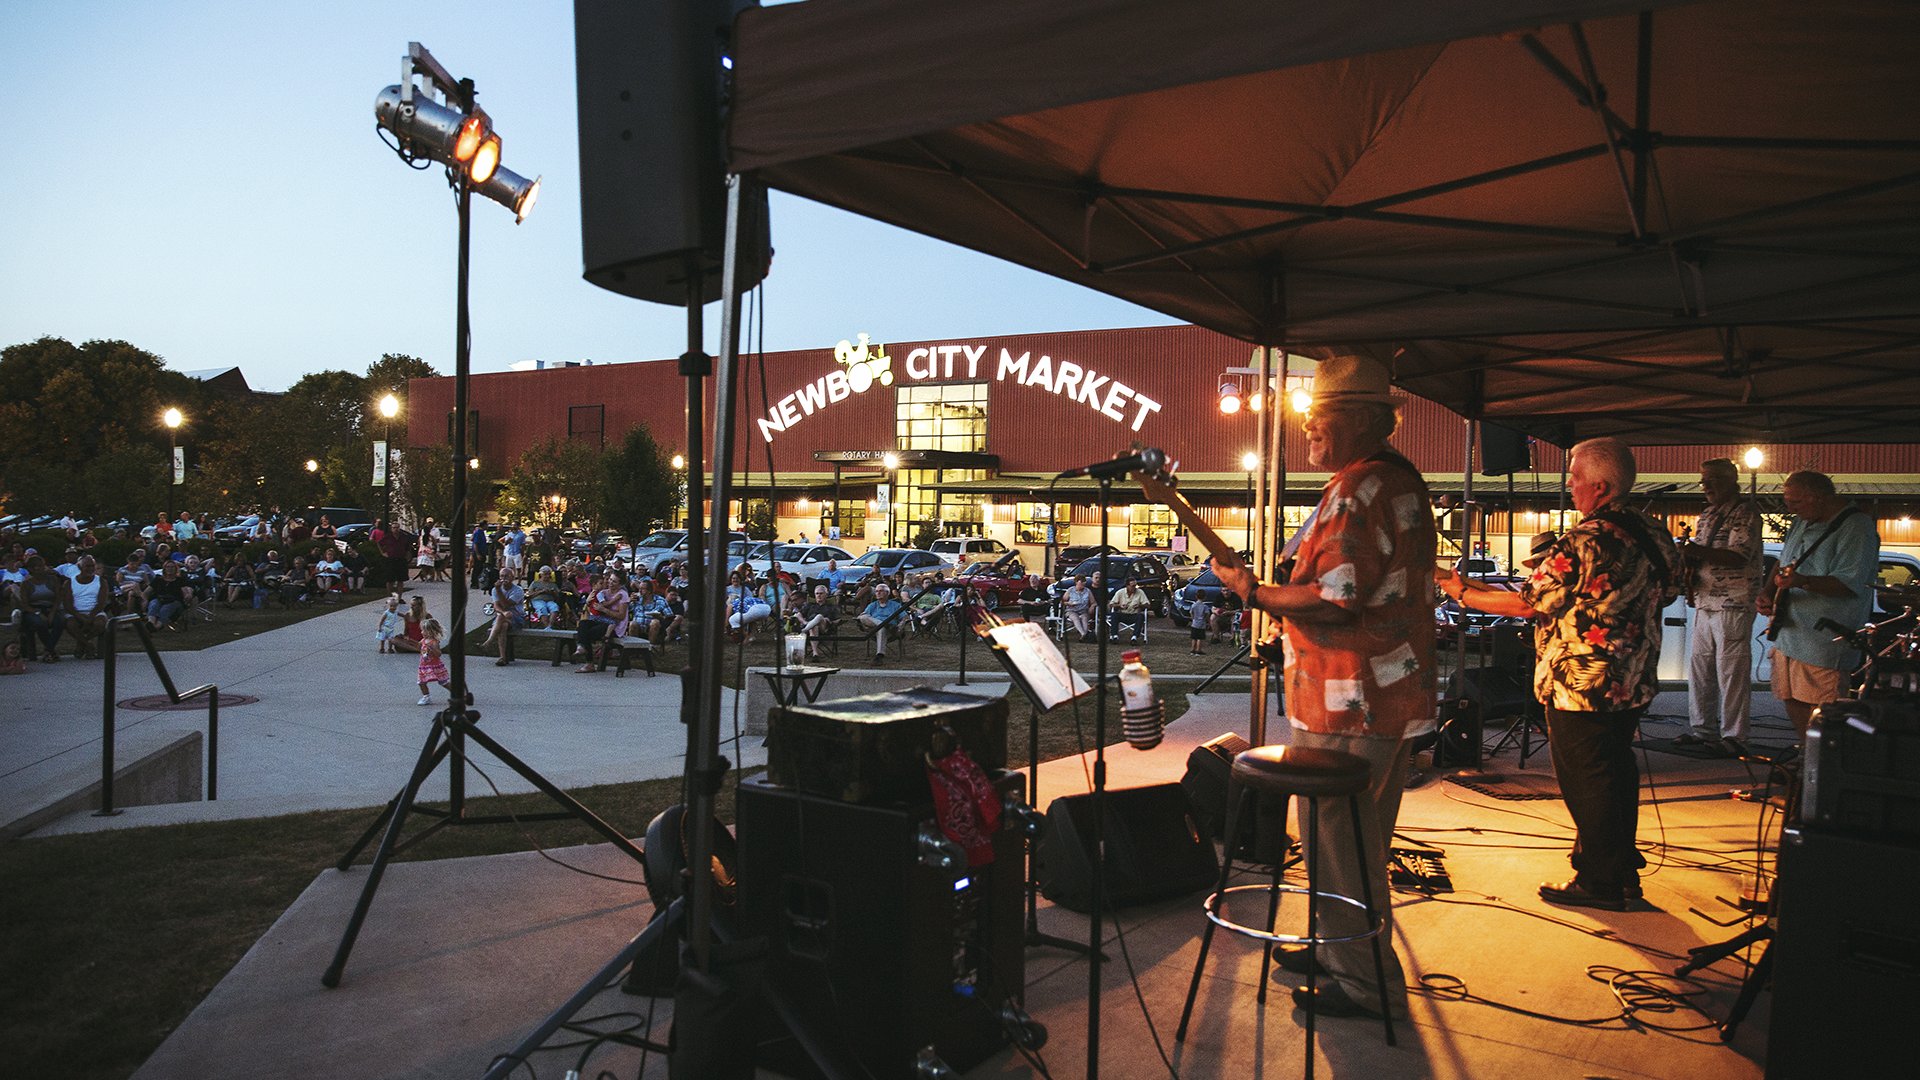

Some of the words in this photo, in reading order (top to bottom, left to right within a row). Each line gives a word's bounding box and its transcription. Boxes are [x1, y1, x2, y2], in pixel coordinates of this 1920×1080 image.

[906, 345, 987, 380] CITY
[997, 347, 1162, 432] MARKET
[842, 451, 871, 459] ROTARY
